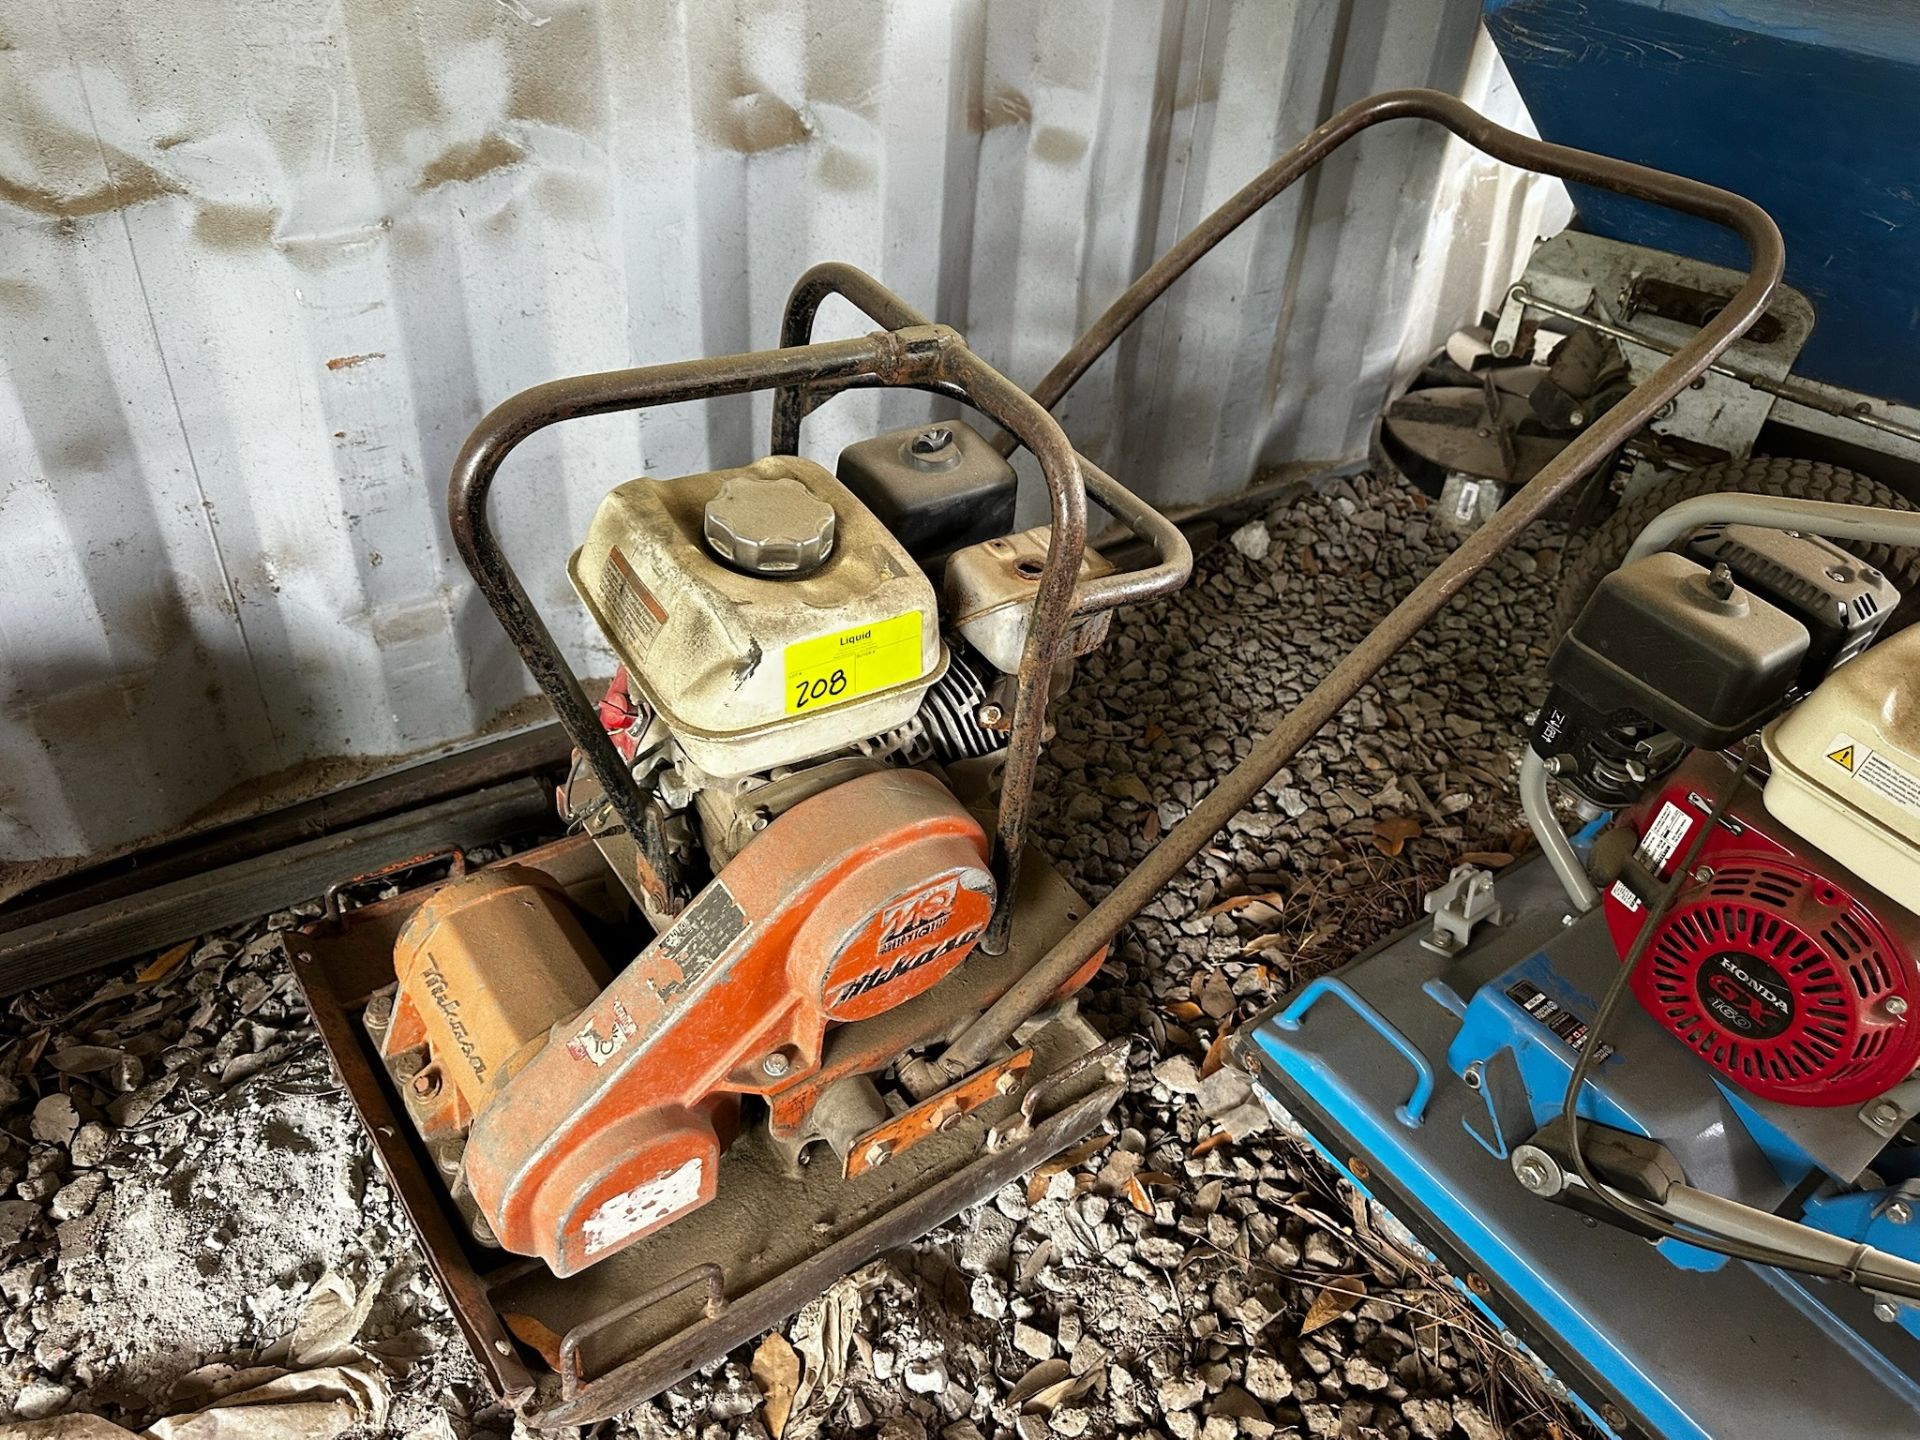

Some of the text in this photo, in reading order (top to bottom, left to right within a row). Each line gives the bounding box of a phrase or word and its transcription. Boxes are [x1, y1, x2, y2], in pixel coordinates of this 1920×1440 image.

[840, 630, 871, 646] Liquid
[796, 669, 847, 708] 208
[1709, 975, 1781, 1028] GX
[1720, 957, 1789, 1014] HONDA
[420, 952, 487, 1084] Mikasa
[1711, 998, 1752, 1029] 160
